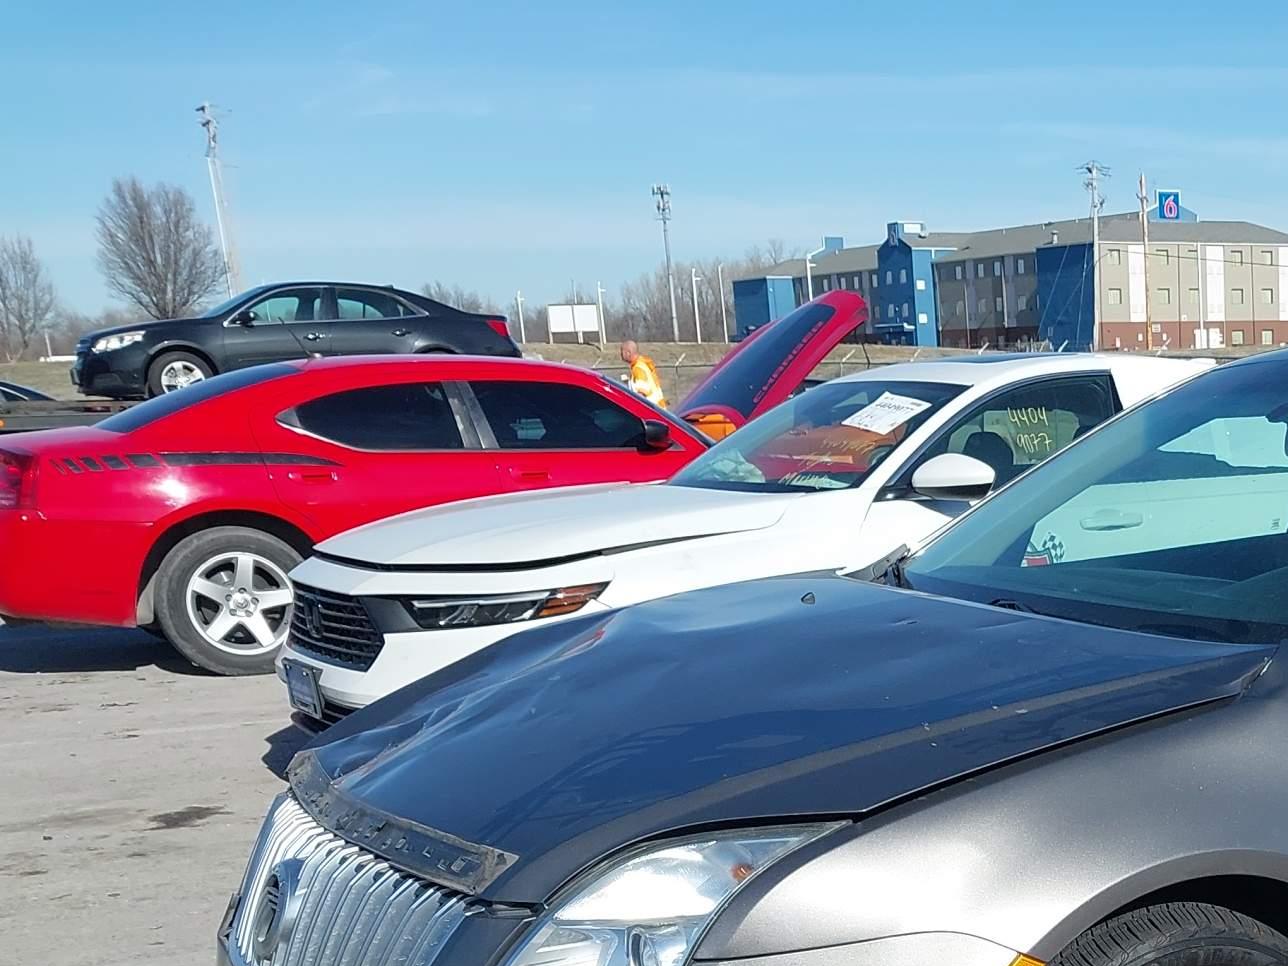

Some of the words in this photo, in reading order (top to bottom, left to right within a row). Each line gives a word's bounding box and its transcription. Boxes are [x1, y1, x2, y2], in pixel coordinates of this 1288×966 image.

[1164, 195, 1177, 217] 6
[1007, 406, 1048, 427] 4404
[1016, 432, 1053, 453] 9077
